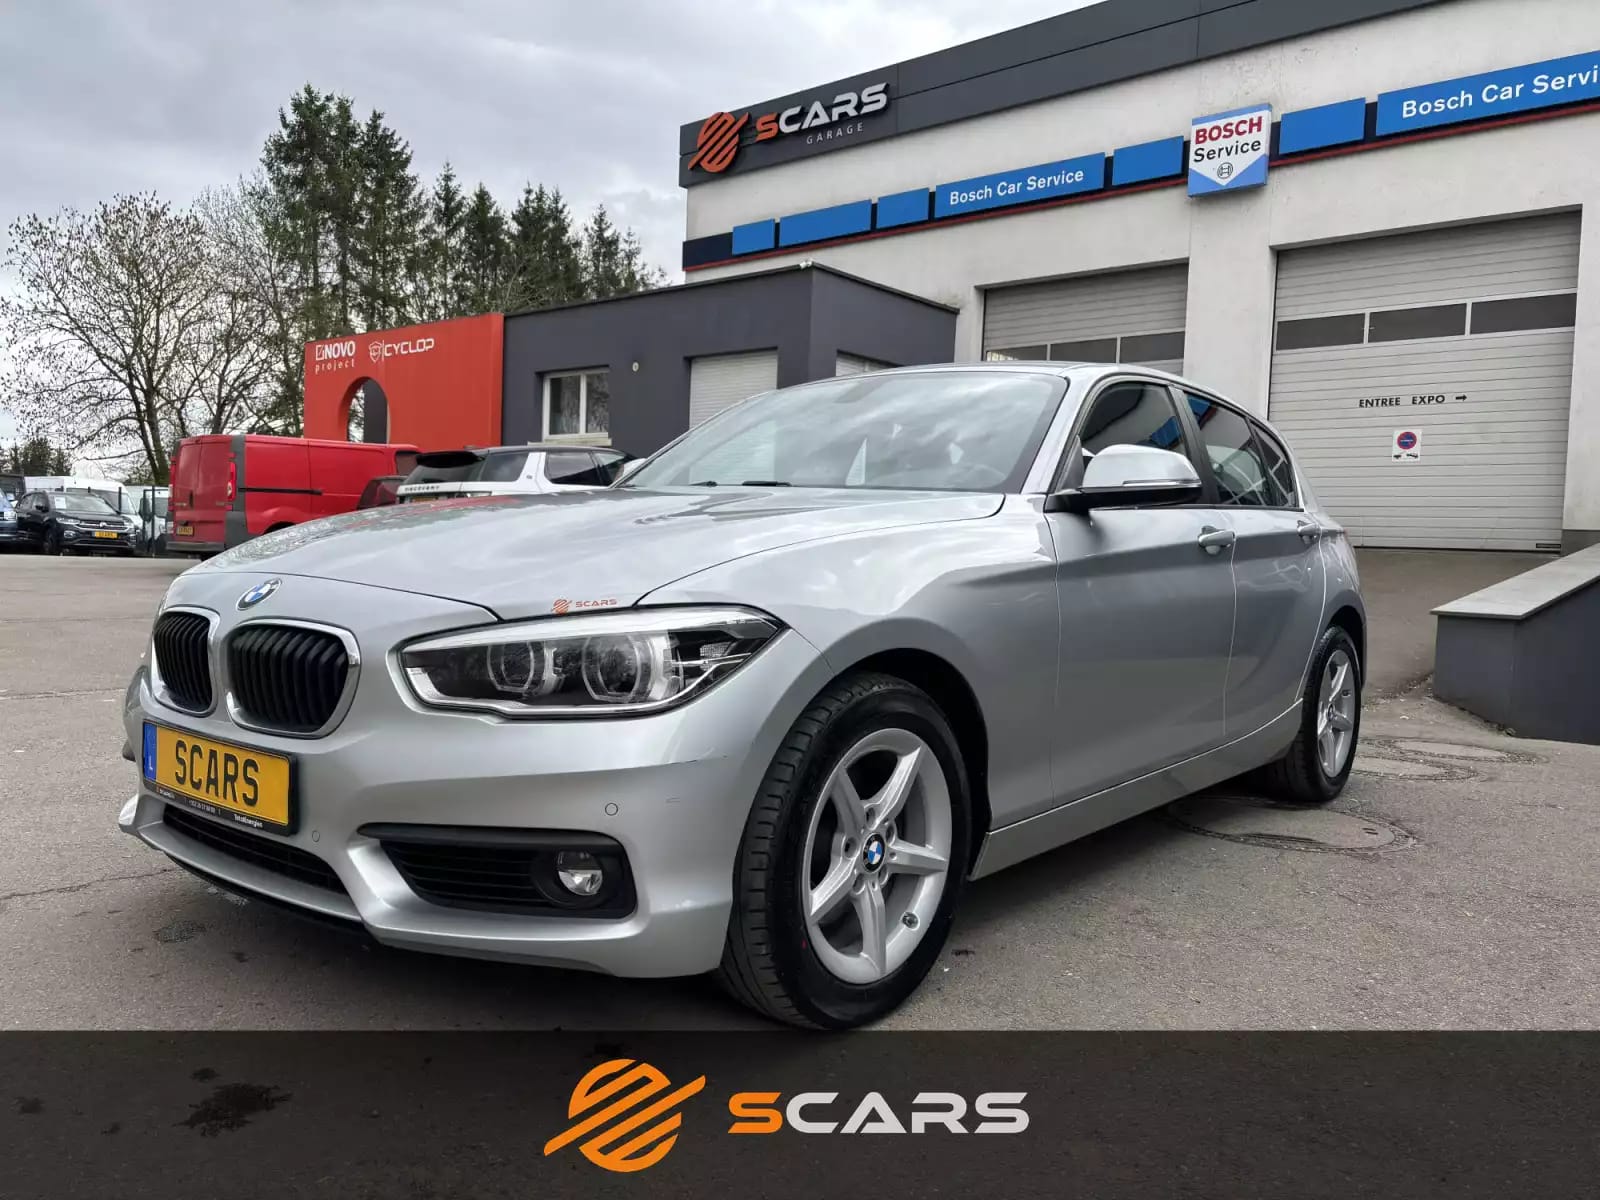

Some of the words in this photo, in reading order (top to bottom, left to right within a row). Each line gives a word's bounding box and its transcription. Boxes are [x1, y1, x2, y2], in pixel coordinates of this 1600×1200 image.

[1402, 90, 1473, 118] Bosch
[1481, 83, 1524, 103] Car
[1532, 65, 1599, 93] Servi
[756, 82, 889, 142] SCARS
[806, 122, 864, 145] GARAGE
[1194, 116, 1262, 145] BOSCH
[1193, 138, 1262, 163] Service
[950, 185, 993, 205] Bosch
[997, 179, 1022, 197] Car
[1027, 168, 1084, 191] Service
[384, 338, 435, 357] CYCLOP
[315, 358, 355, 375] project
[1359, 397, 1400, 408] ENTREE
[1411, 395, 1446, 405] EXPO
[575, 599, 617, 608] SCARS
[175, 739, 260, 807] SCARS
